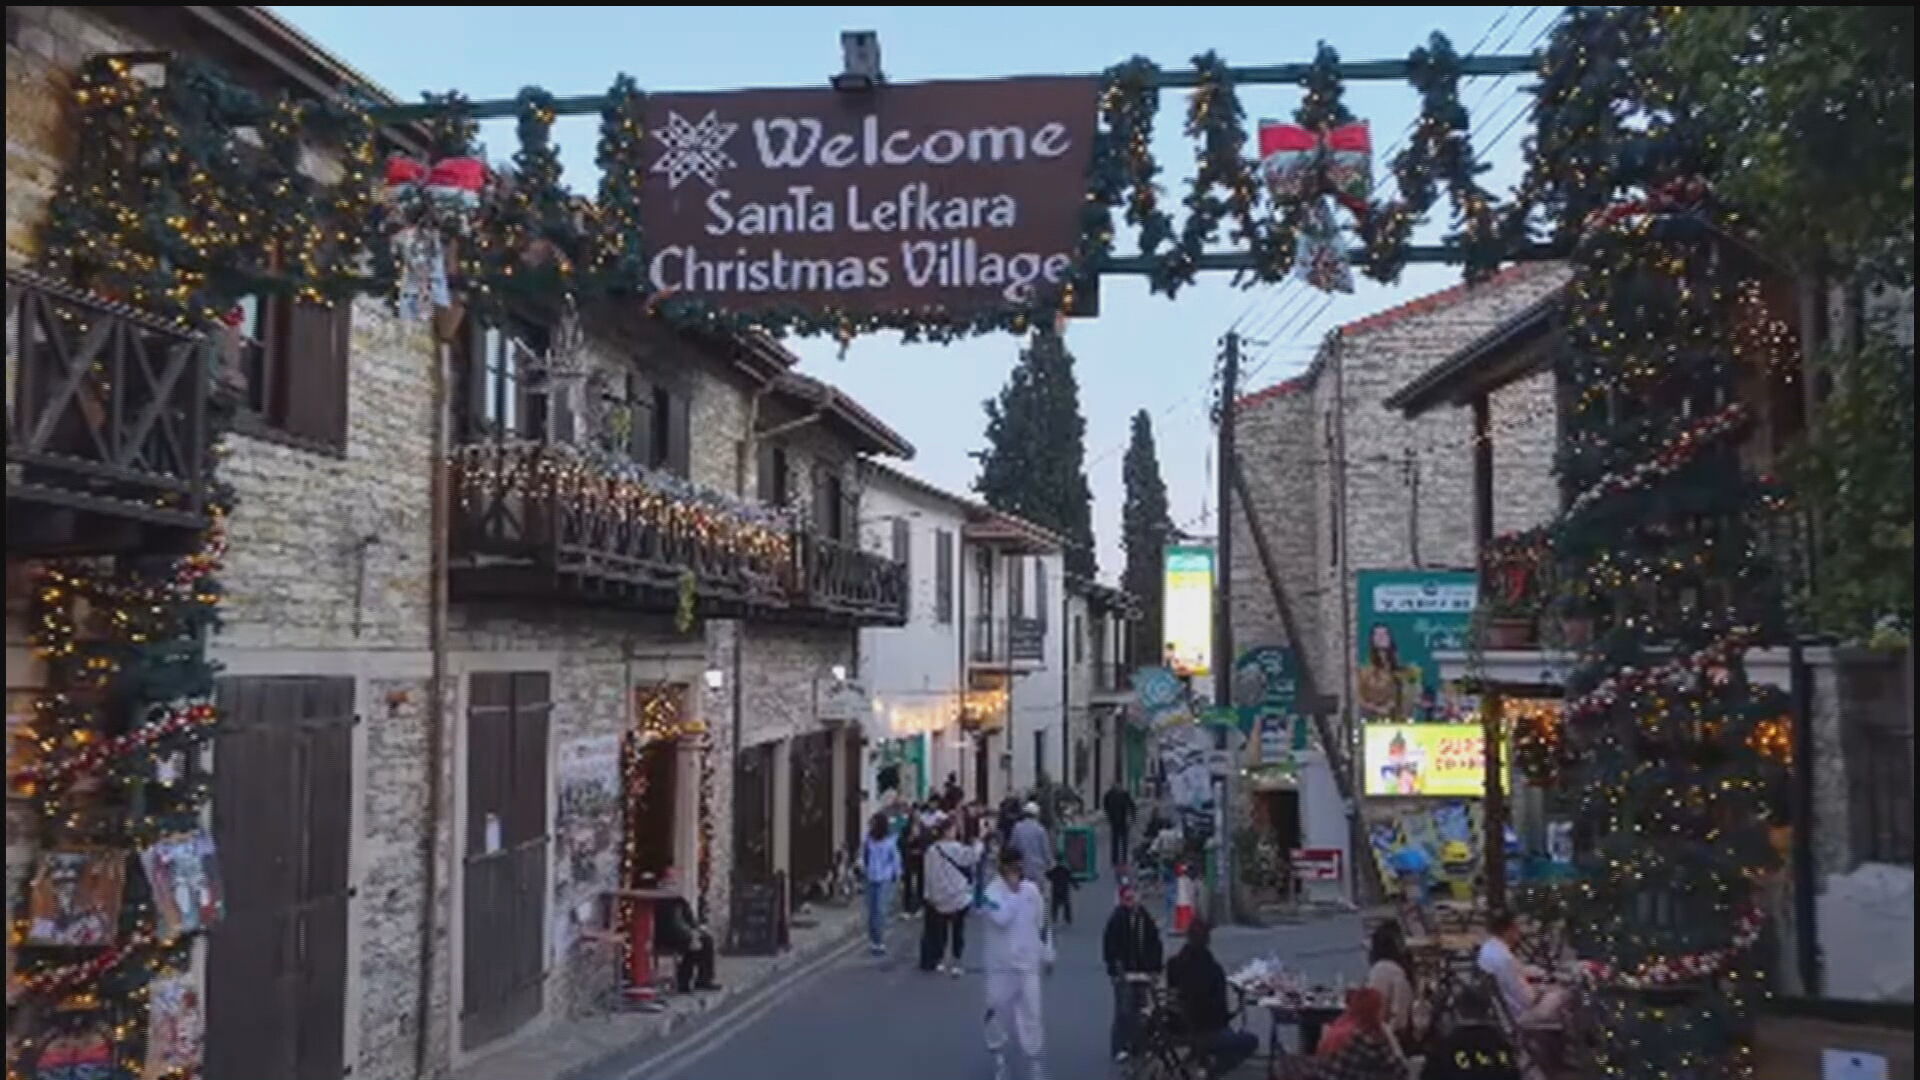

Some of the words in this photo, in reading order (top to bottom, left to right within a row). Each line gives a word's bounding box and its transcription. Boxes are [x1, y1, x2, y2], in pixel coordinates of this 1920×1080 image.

[752, 115, 1070, 169] Welcome
[848, 182, 1017, 232] Lefkara
[649, 245, 889, 293] Christmas
[902, 238, 1071, 302] Village
